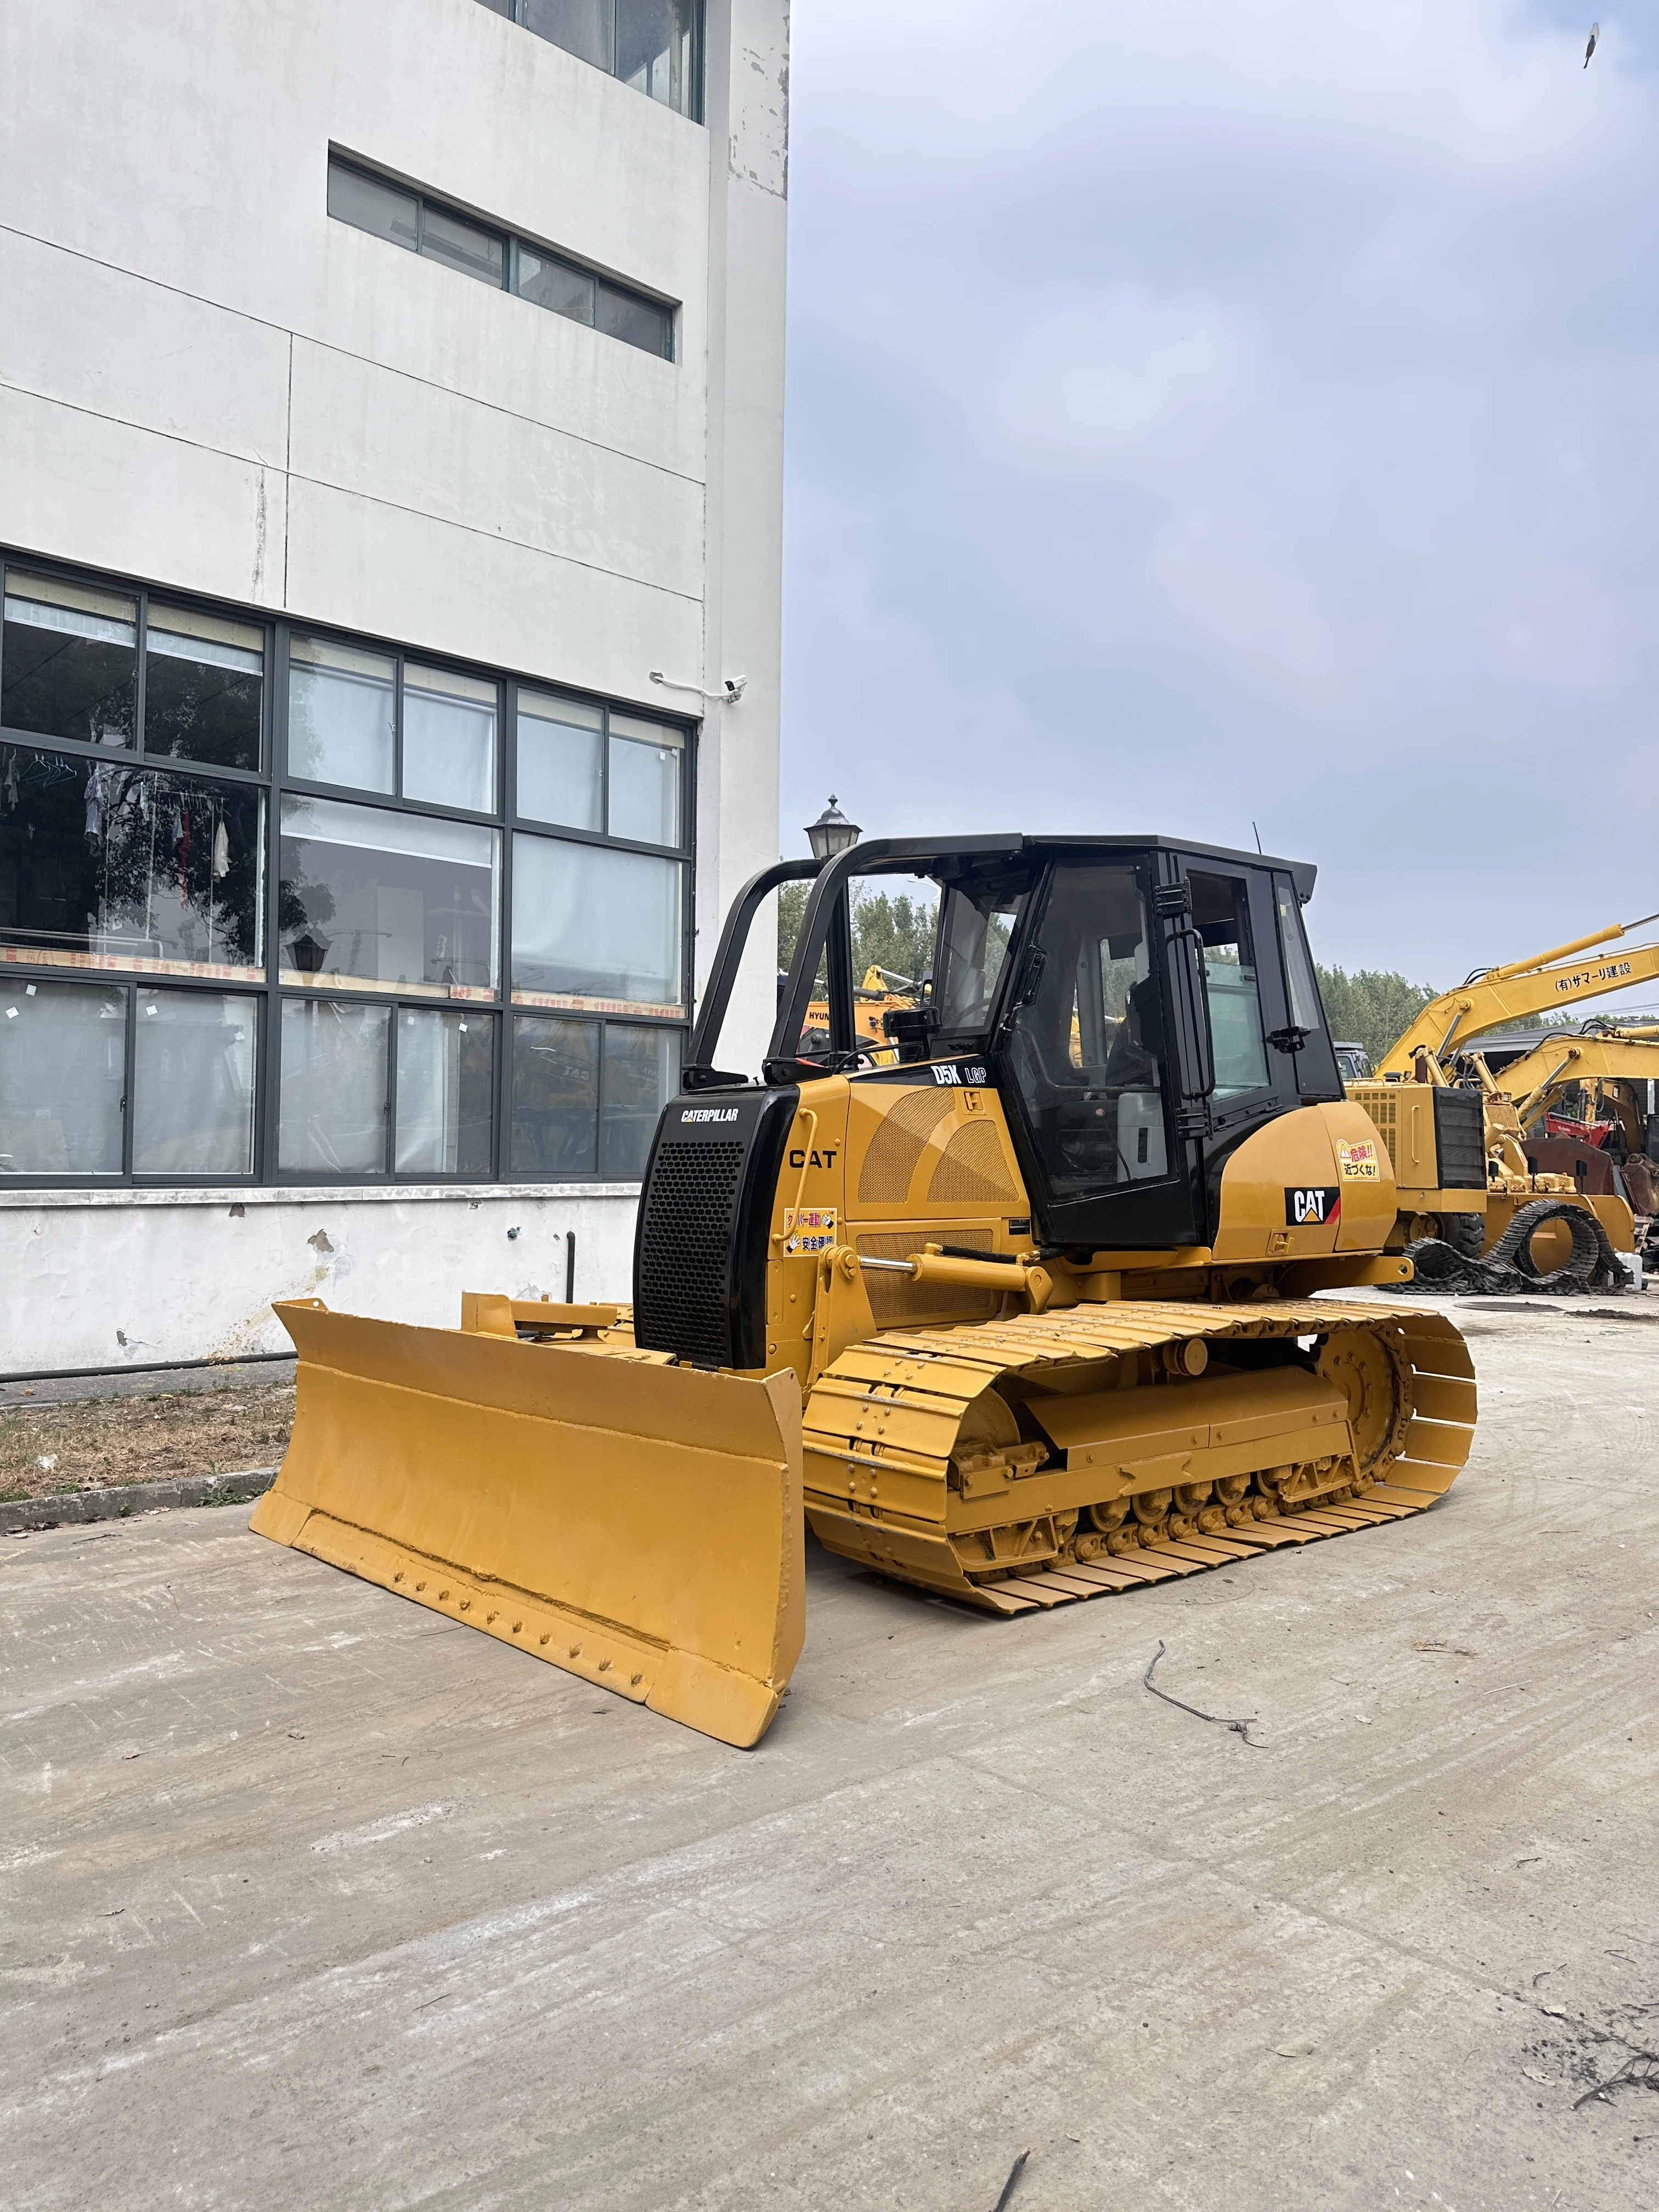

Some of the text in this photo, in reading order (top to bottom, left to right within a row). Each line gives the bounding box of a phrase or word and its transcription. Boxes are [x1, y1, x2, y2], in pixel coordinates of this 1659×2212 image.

[930, 1065, 986, 1084] D5K LGP
[681, 1108, 738, 1122] CATERPILLAR
[790, 1150, 837, 1168] CAT
[1294, 1190, 1325, 1222] CAT
